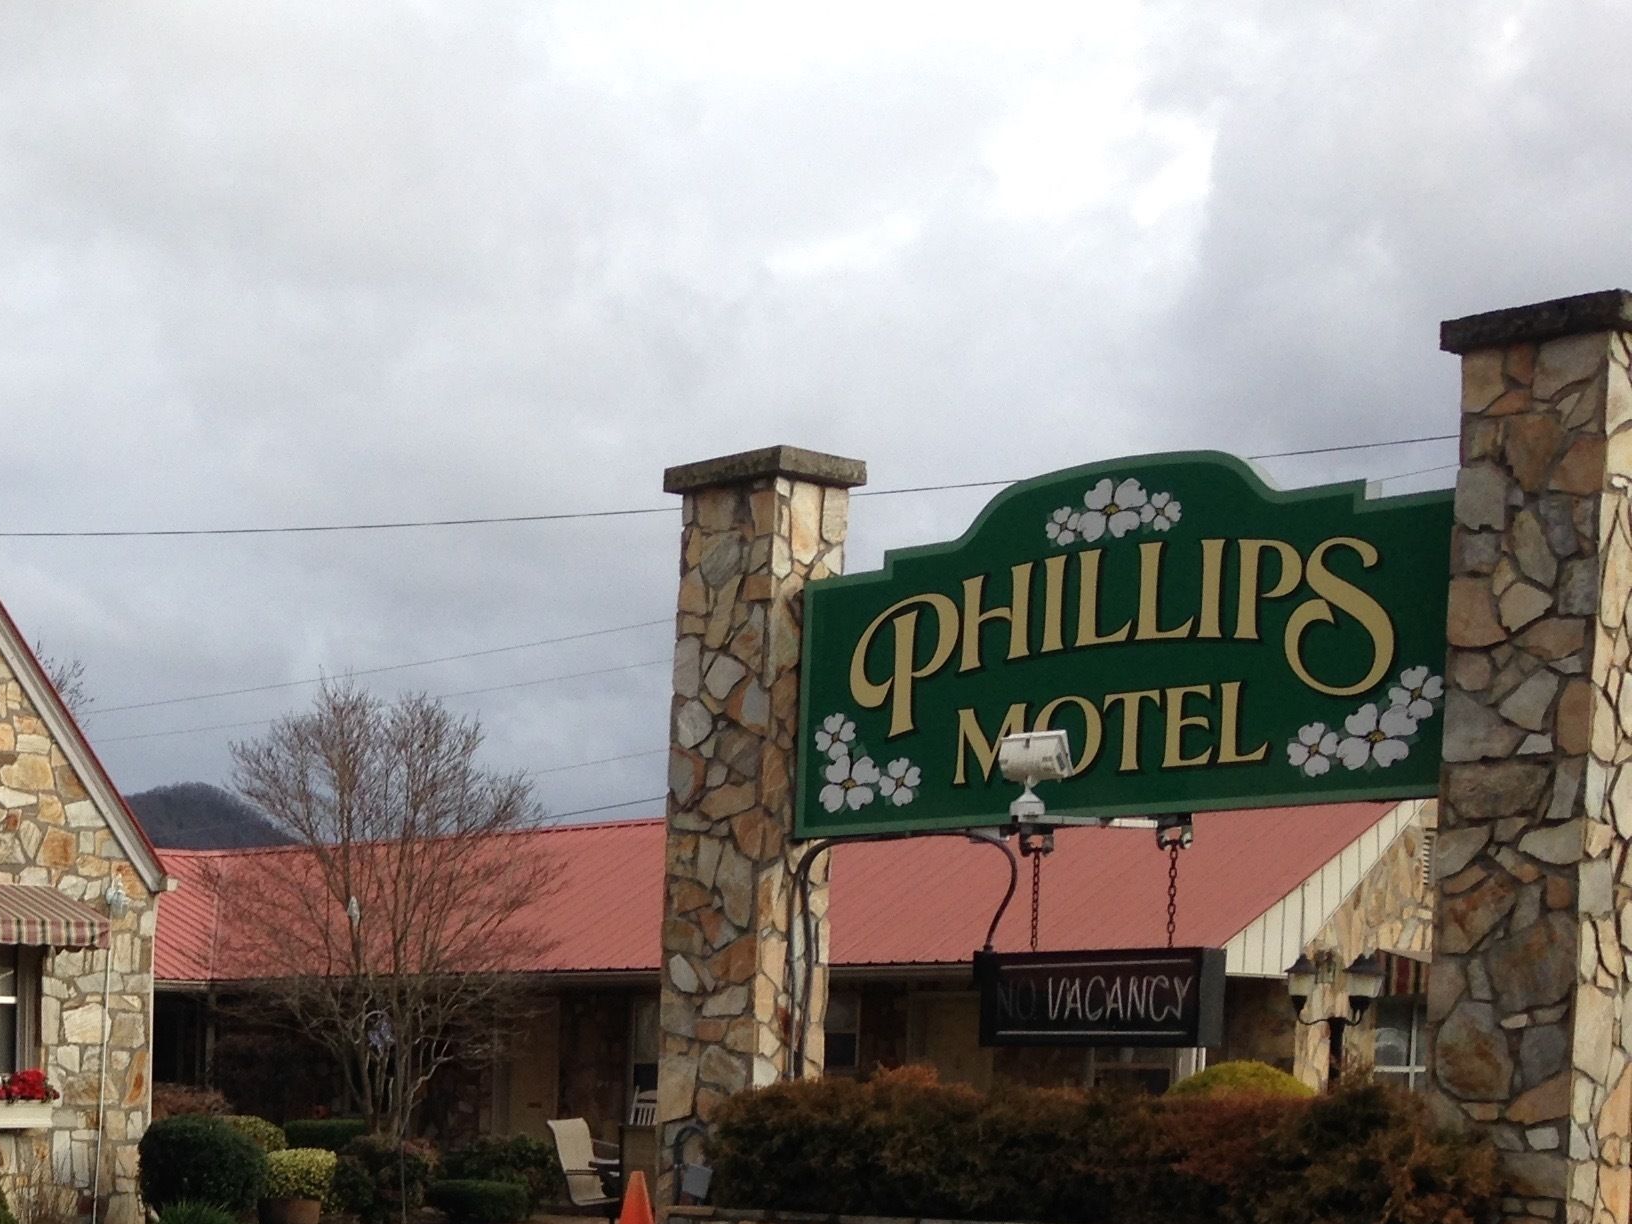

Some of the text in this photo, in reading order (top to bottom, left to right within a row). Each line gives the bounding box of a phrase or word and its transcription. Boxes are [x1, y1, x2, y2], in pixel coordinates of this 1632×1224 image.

[849, 536, 1395, 739] PHILLIPS
[952, 680, 1269, 785] MOTEL
[996, 974, 1193, 1023] NO VACANCY
